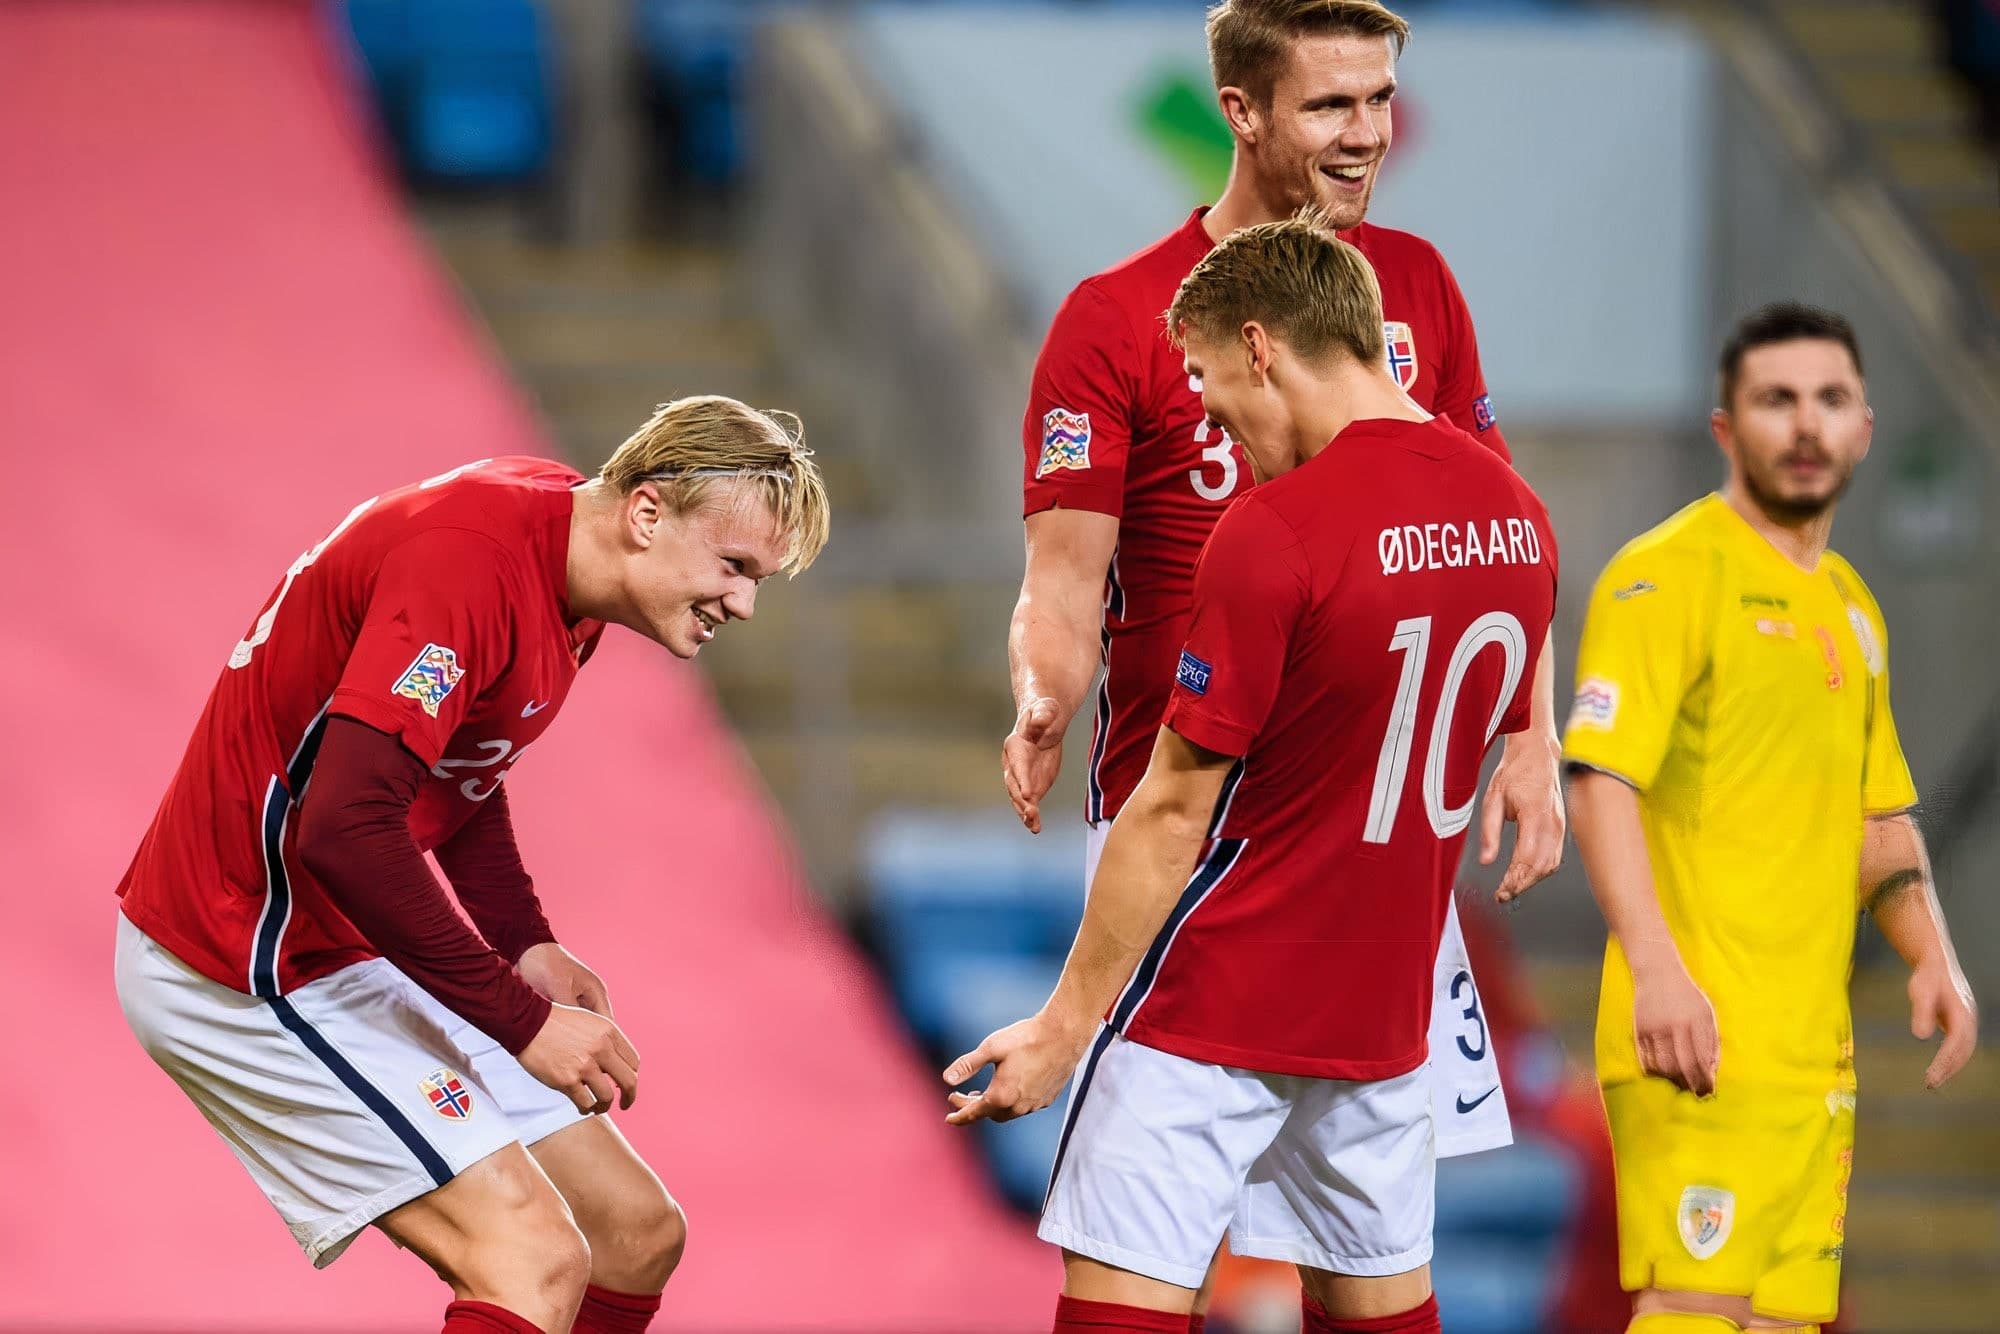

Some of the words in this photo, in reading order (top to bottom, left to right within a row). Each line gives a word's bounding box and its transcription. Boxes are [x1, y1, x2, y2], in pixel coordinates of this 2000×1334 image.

[1188, 419, 1239, 501] 3
[1378, 517, 1542, 577] ØDEGAARD
[1361, 610, 1528, 845] 10
[1450, 970, 1486, 1062] 3
